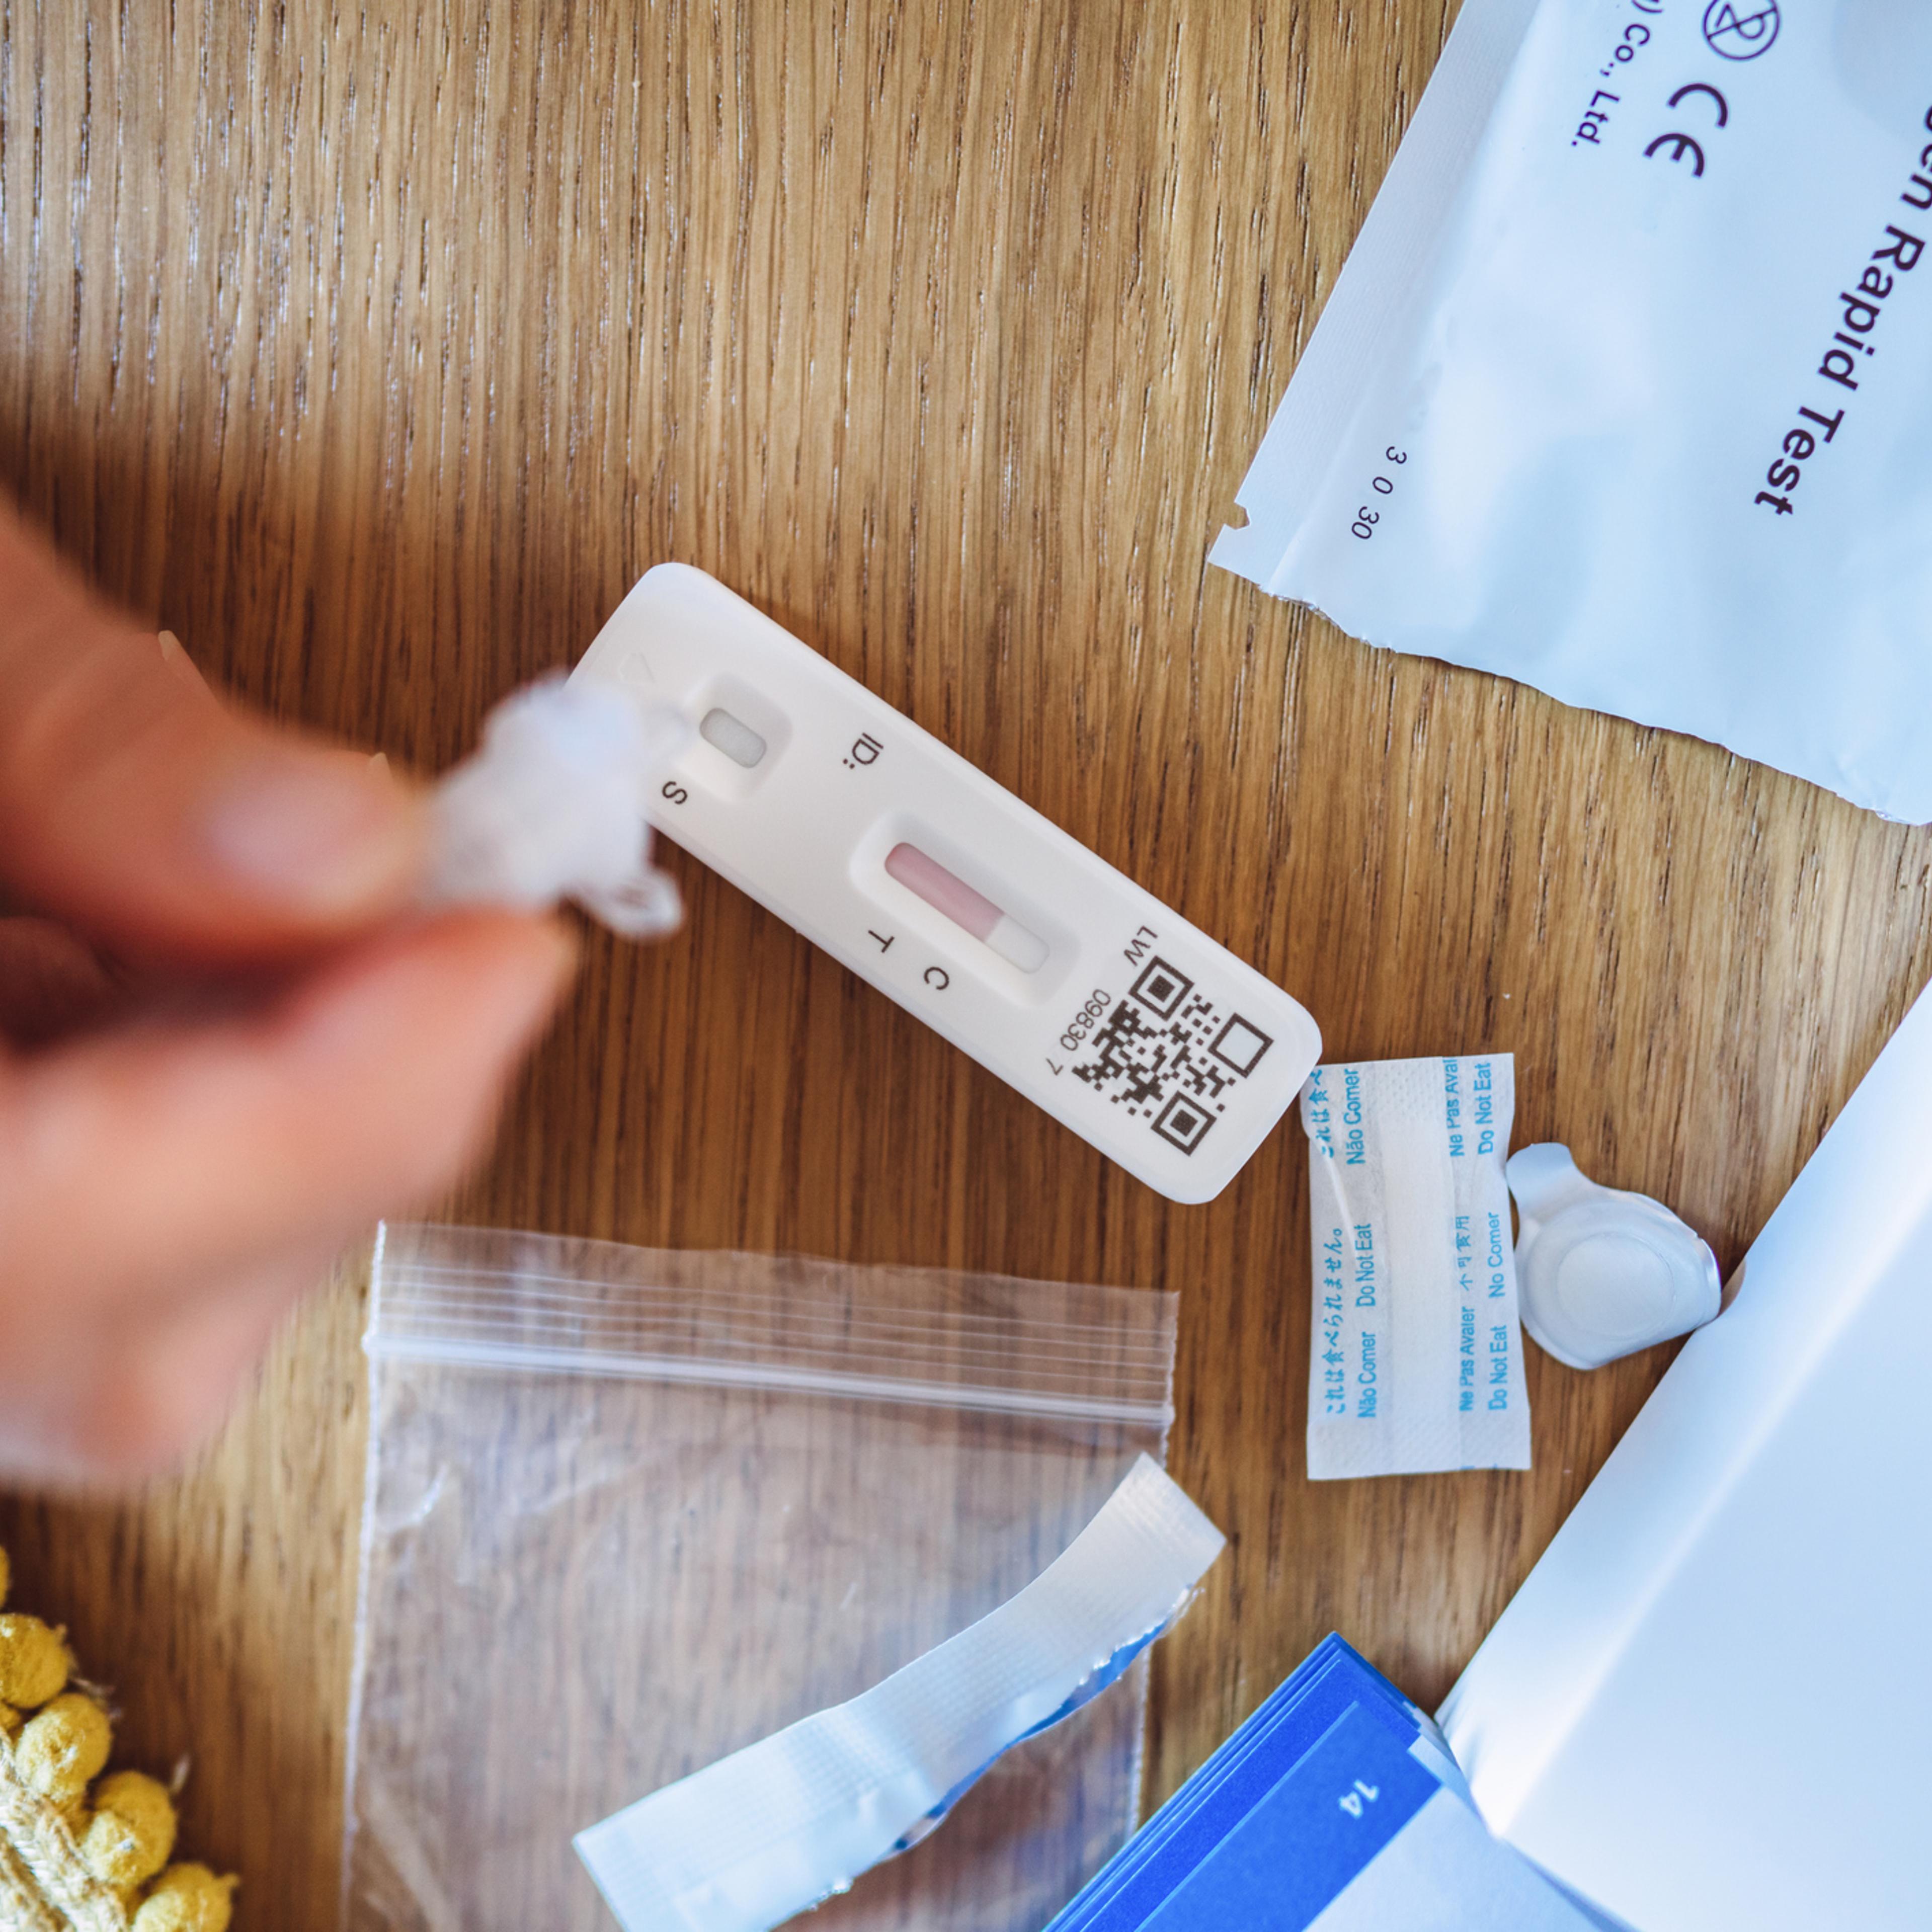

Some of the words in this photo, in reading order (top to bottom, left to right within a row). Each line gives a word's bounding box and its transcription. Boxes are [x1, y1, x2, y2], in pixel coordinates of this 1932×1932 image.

[1600, 23, 1651, 77] Co.,
[1571, 90, 1620, 146] Ltd.
[1817, 224, 1926, 391] Rapid
[1754, 406, 1845, 516] Test
[1351, 506, 1380, 540] 30
[842, 733, 883, 770] ID:
[661, 780, 689, 805] S
[868, 929, 895, 953] T
[1123, 925, 1158, 967] LW
[922, 967, 950, 993] C
[1060, 989, 1111, 1051] 09830
[1474, 1063, 1491, 1091] Eat
[1343, 1069, 1361, 1124] Comer
[1475, 1095, 1493, 1124] Not
[1446, 1099, 1460, 1129] Pas
[1346, 1129, 1365, 1165] Não
[1449, 1134, 1465, 1157] Ne
[1478, 1130, 1494, 1154] Do
[1353, 1224, 1372, 1250] Eat
[1487, 1212, 1503, 1268] Comer
[1356, 1254, 1375, 1281] Not
[1356, 1285, 1375, 1307] Do
[1488, 1273, 1505, 1298] No
[1460, 1306, 1475, 1355] Avaler
[1489, 1325, 1507, 1352] Eat
[1358, 1331, 1376, 1384] Comer
[1489, 1356, 1507, 1384] Not
[1460, 1360, 1474, 1386] Pas
[1358, 1388, 1376, 1418] Não
[1460, 1392, 1474, 1411] Ne
[1488, 1390, 1507, 1410] Do
[1339, 1779, 1380, 1819] 14
